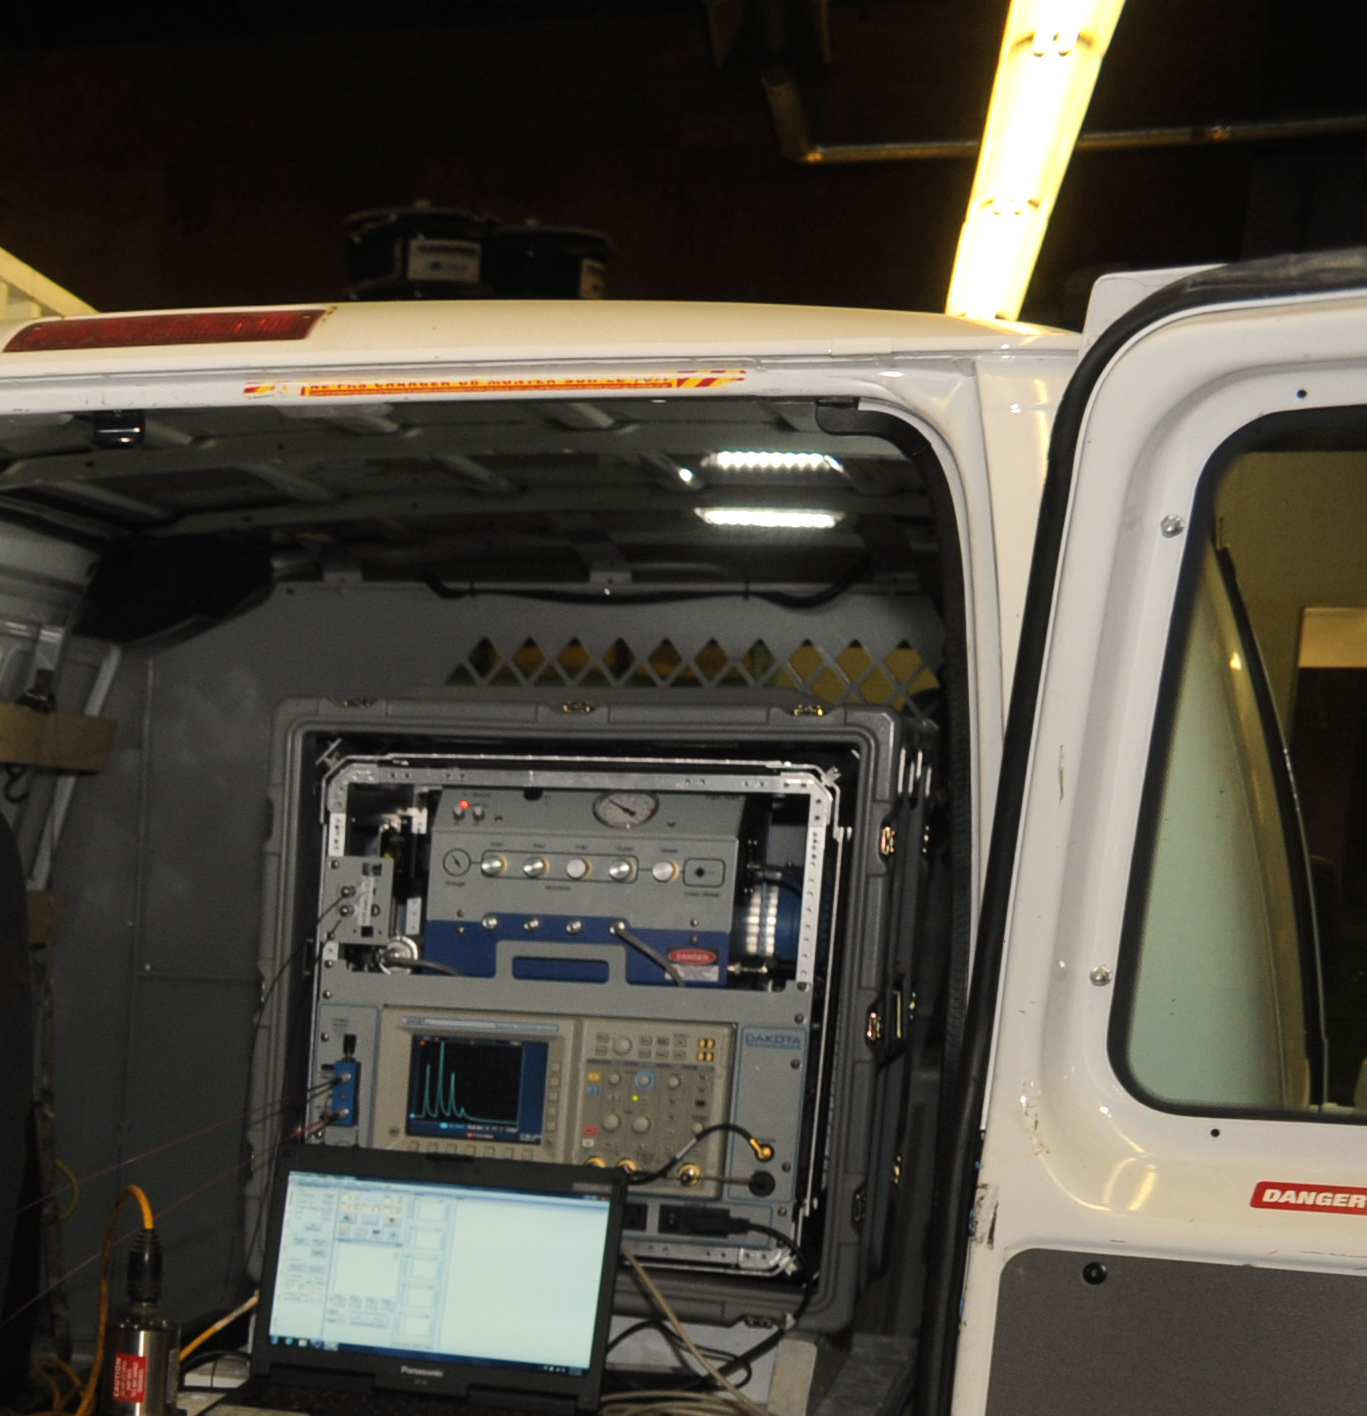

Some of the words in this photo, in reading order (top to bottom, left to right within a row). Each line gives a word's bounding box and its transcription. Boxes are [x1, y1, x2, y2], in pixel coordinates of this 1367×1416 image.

[745, 1033, 802, 1046] DAKOTA
[1261, 1188, 1367, 1209] DANGER
[399, 1365, 444, 1379] Panasonic
